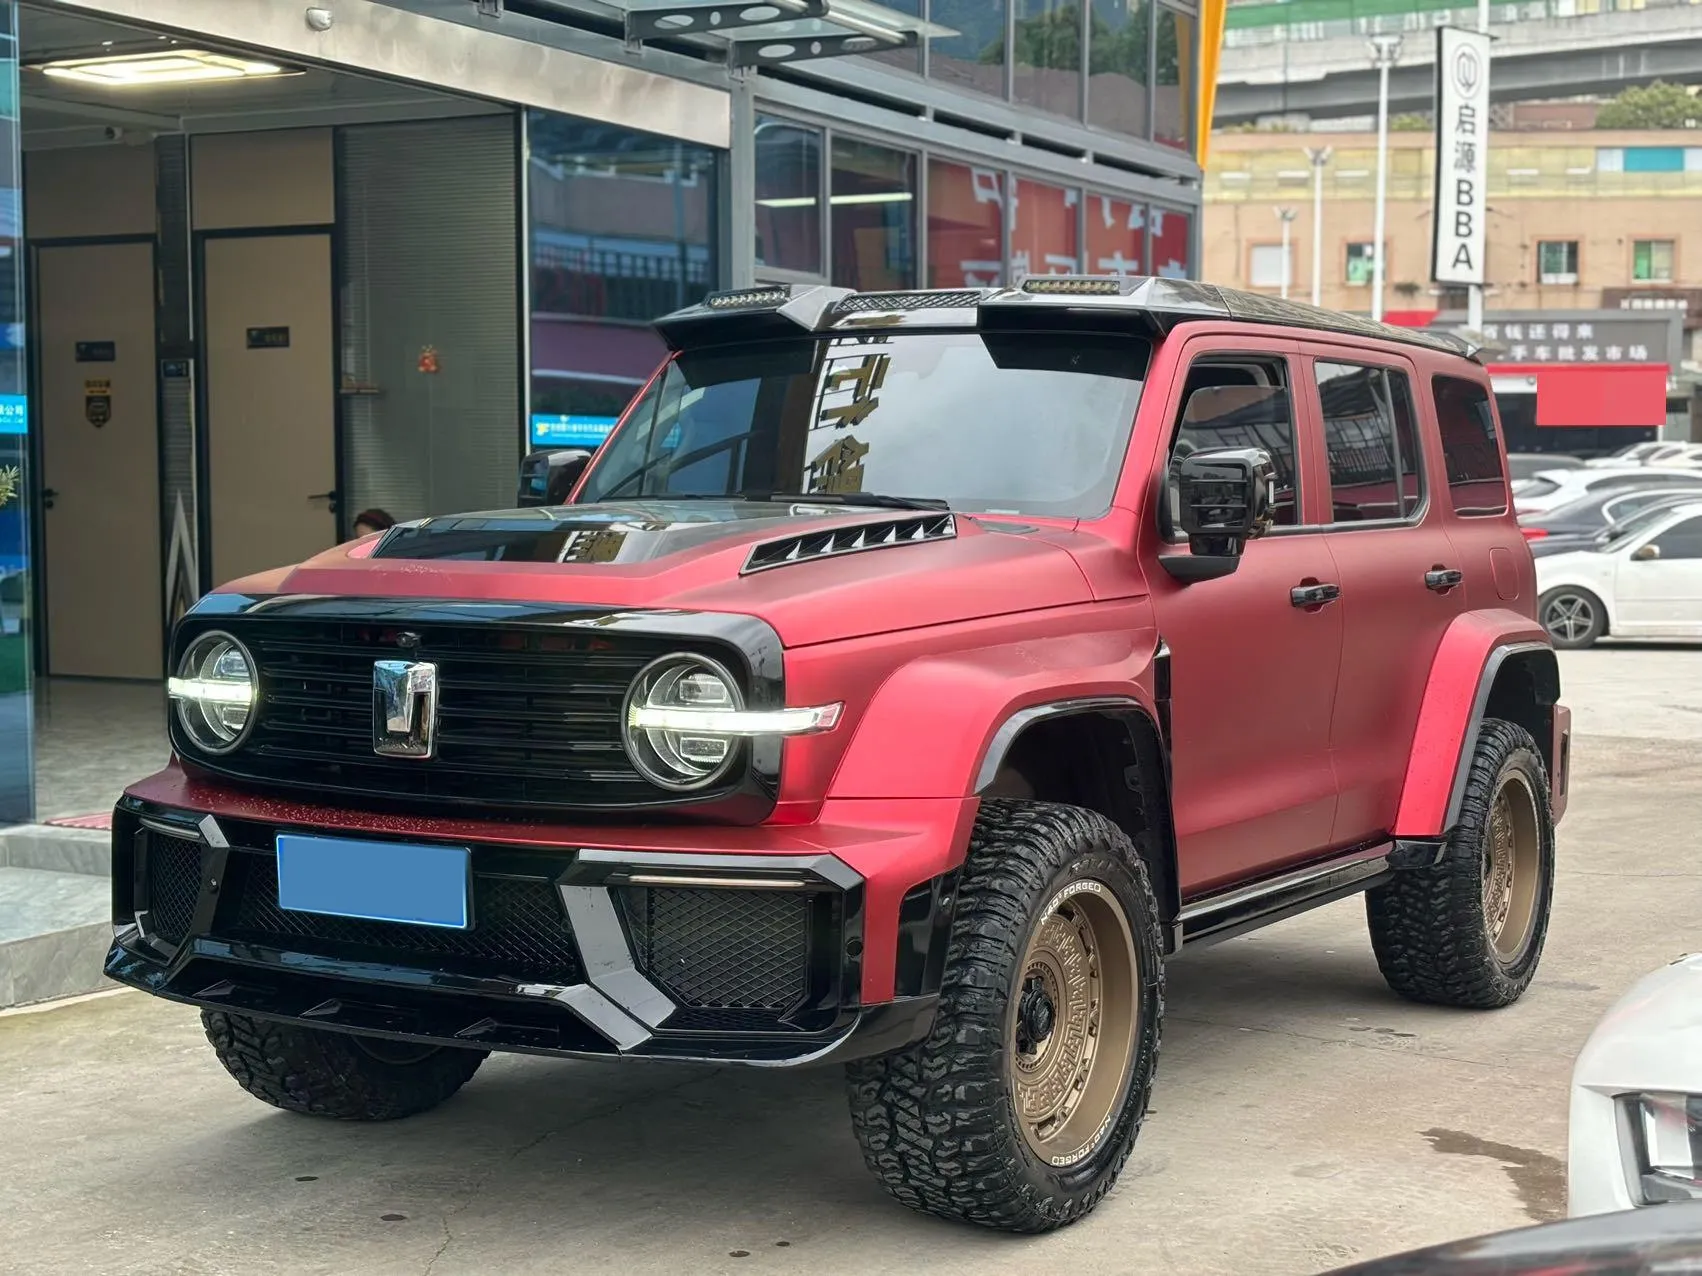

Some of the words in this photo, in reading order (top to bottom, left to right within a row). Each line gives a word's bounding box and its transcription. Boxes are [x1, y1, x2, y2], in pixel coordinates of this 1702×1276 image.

[1496, 344, 1649, 361] 手车批发市场
[1063, 882, 1101, 898] FORGED
